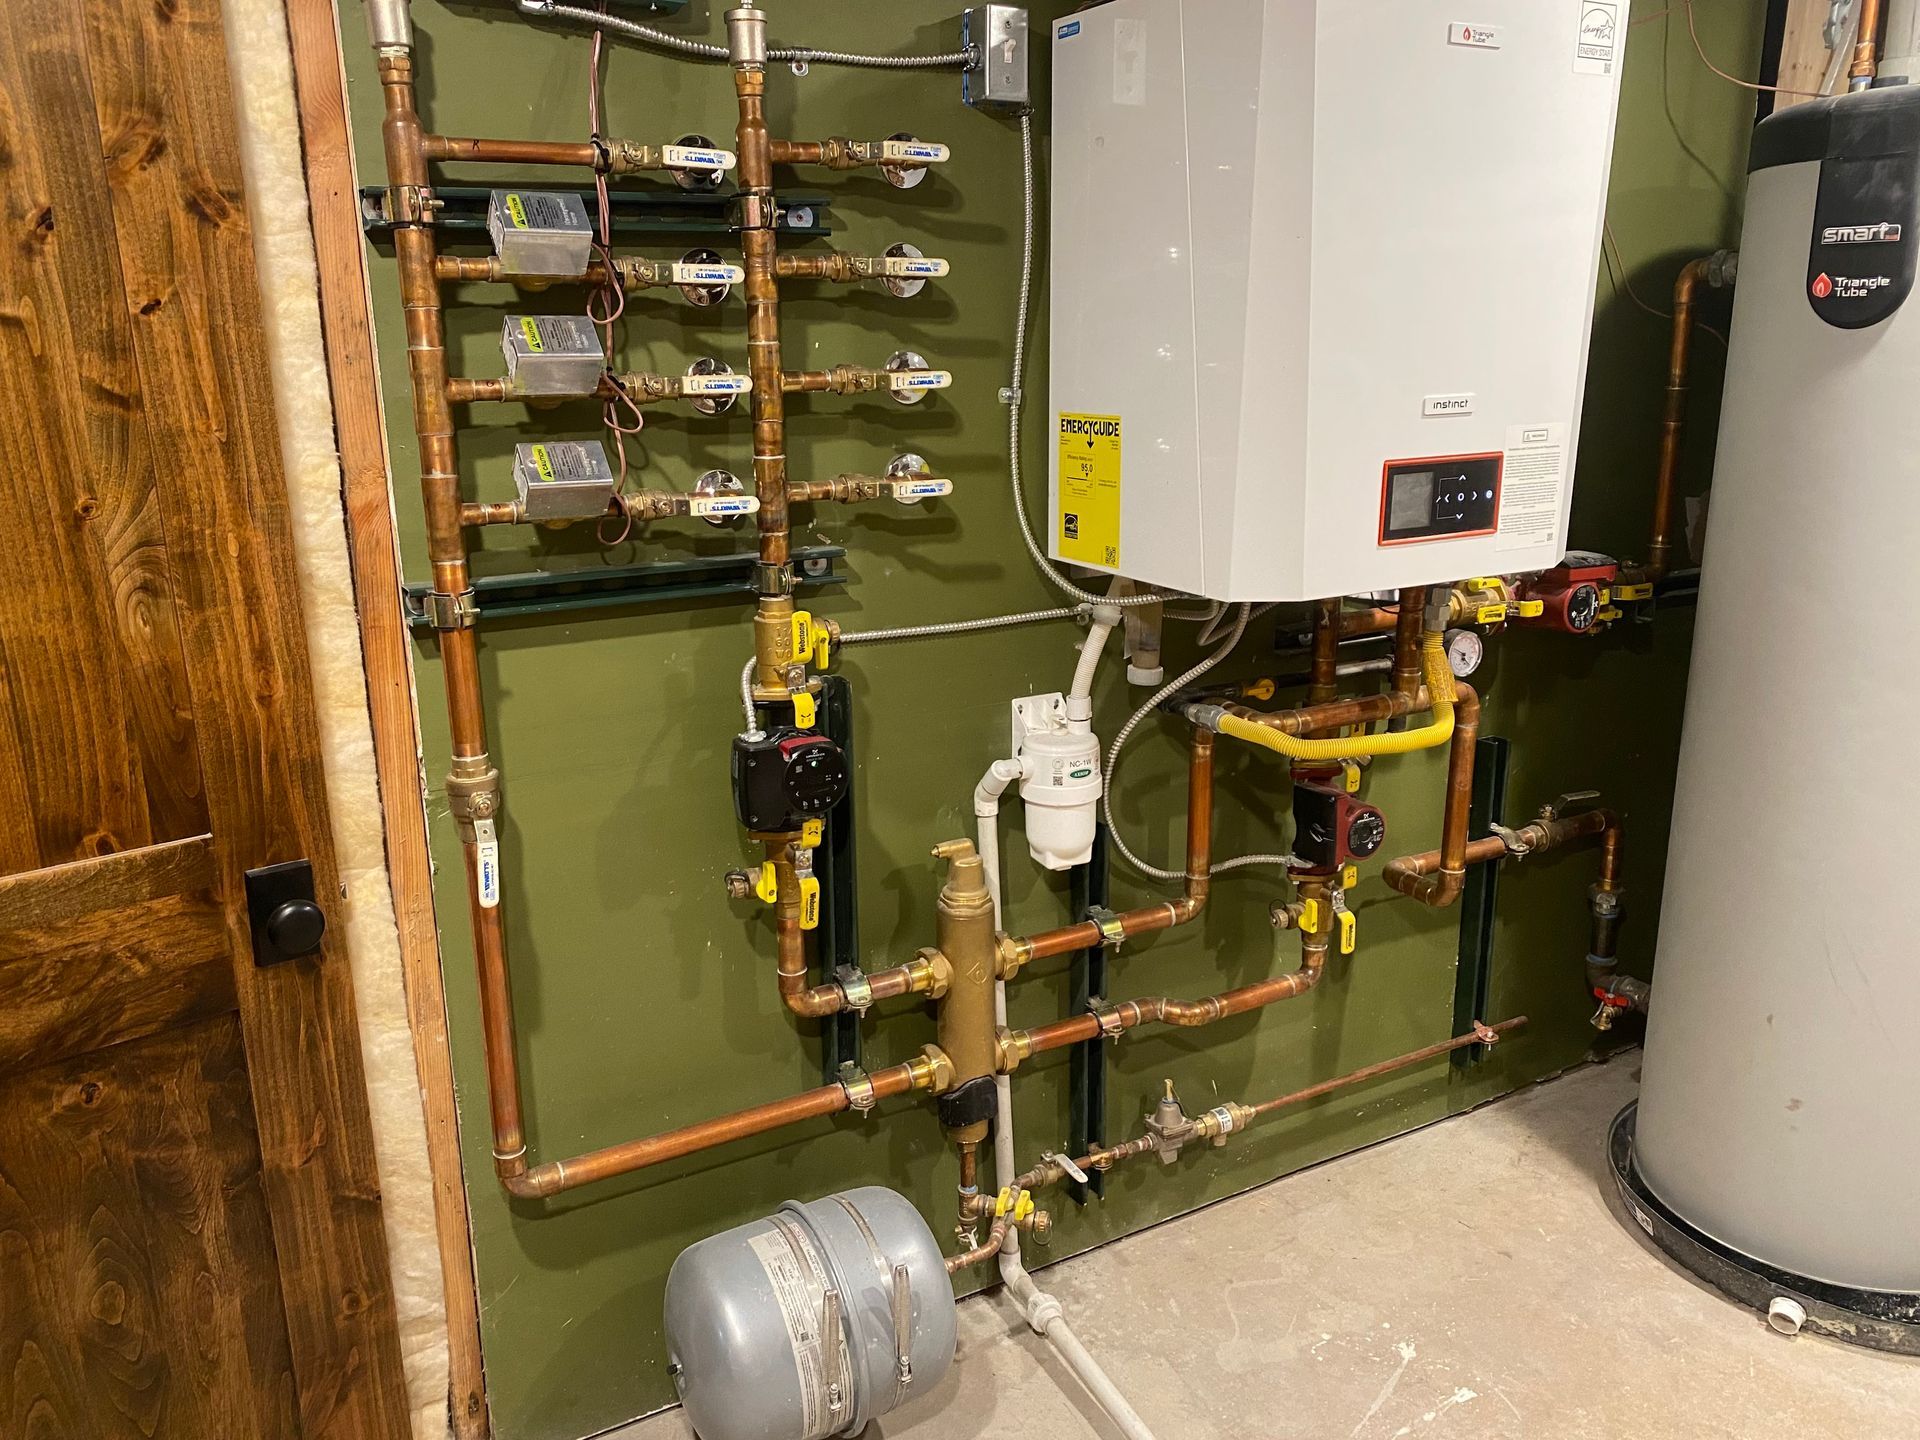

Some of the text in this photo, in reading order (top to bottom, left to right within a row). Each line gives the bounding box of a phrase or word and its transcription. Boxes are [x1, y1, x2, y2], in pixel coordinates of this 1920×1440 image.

[1472, 29, 1494, 39] Triangle
[904, 149, 932, 157] WATTS
[684, 155, 715, 164] WATTS
[511, 197, 523, 219] CAUTION
[1823, 224, 1890, 242] smart
[695, 272, 726, 280] WATTS
[1834, 276, 1891, 289] Triangle
[1834, 287, 1868, 297] Tube
[526, 320, 538, 343] CAUTION
[1433, 399, 1468, 409] instinct
[1060, 418, 1120, 437] ENERGYGUIDE
[536, 448, 549, 471] CAUTION
[1081, 463, 1094, 473] 95.0
[798, 622, 806, 655] Webstone
[1069, 758, 1092, 768] NC-1W
[808, 891, 817, 921] Webstone
